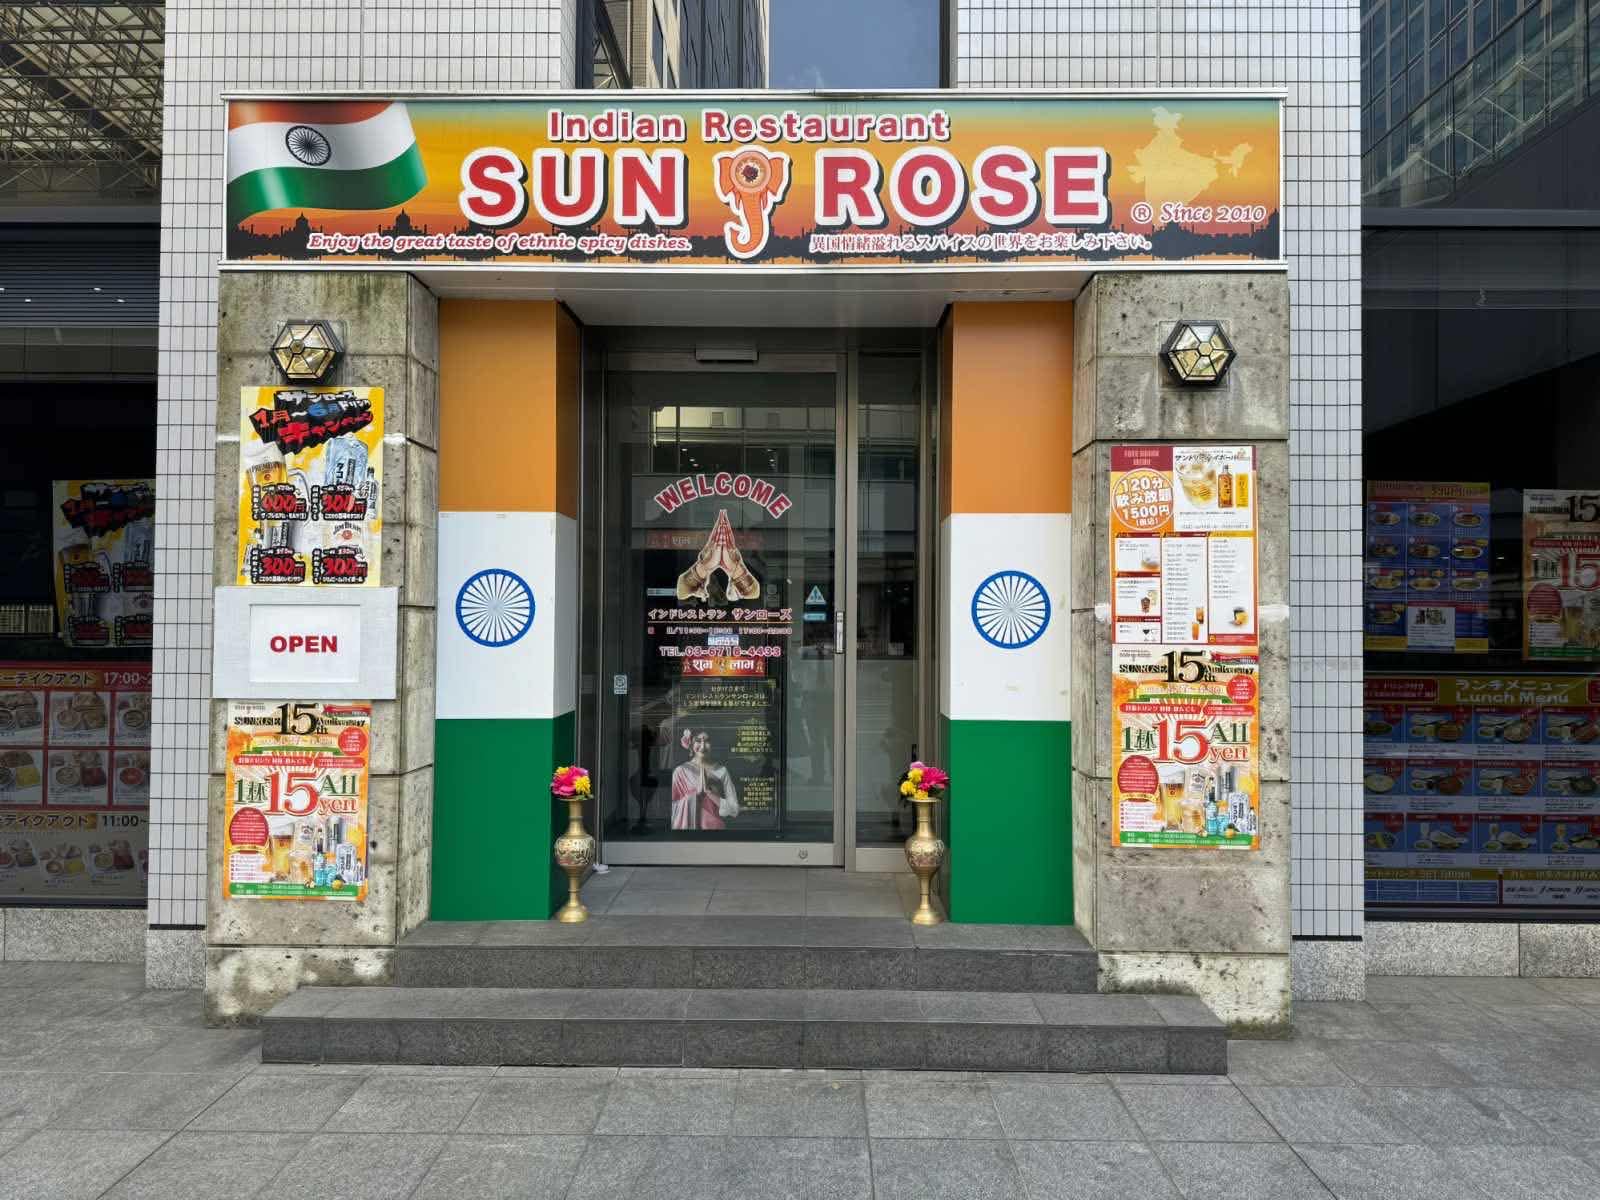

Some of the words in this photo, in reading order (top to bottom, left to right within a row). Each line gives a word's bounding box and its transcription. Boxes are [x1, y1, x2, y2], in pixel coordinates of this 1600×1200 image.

[549, 109, 685, 141] Indian
[703, 109, 949, 140] Restaurant
[463, 151, 676, 223] SUN
[819, 150, 1104, 221] ROSE
[1160, 203, 1212, 224] Since
[1217, 205, 1267, 222] 2010
[309, 234, 359, 251] Enjoy
[362, 234, 392, 248] the
[395, 236, 443, 251] great
[448, 234, 492, 248] taste
[496, 234, 516, 251] of
[519, 234, 575, 248] ethnic
[578, 235, 627, 252] spicy
[630, 234, 691, 249] dishes.
[810, 233, 1152, 251] 異国情緒溢れるスパイスの世界をお楽しみ下さい。
[1121, 476, 1164, 492] 120分
[653, 472, 793, 519] WELCOME
[1116, 488, 1172, 508] 飲み放題
[1122, 504, 1171, 521] 1500円
[648, 608, 727, 620] インドレストラン
[732, 608, 793, 620] サンローズ
[270, 636, 338, 653] OPEN
[1162, 650, 1206, 683] 15
[0, 672, 94, 686] ーテイクアウト
[1455, 690, 1514, 704] Lunch
[1519, 690, 1569, 704] Menu
[277, 702, 320, 735] 15
[1121, 726, 1157, 752] 1杯
[1152, 720, 1210, 765] 15
[1209, 722, 1249, 743] All
[1209, 745, 1249, 765] yen
[234, 779, 268, 804] 1杯
[264, 771, 320, 816] 15
[319, 775, 359, 796] All
[319, 798, 359, 815] yen
